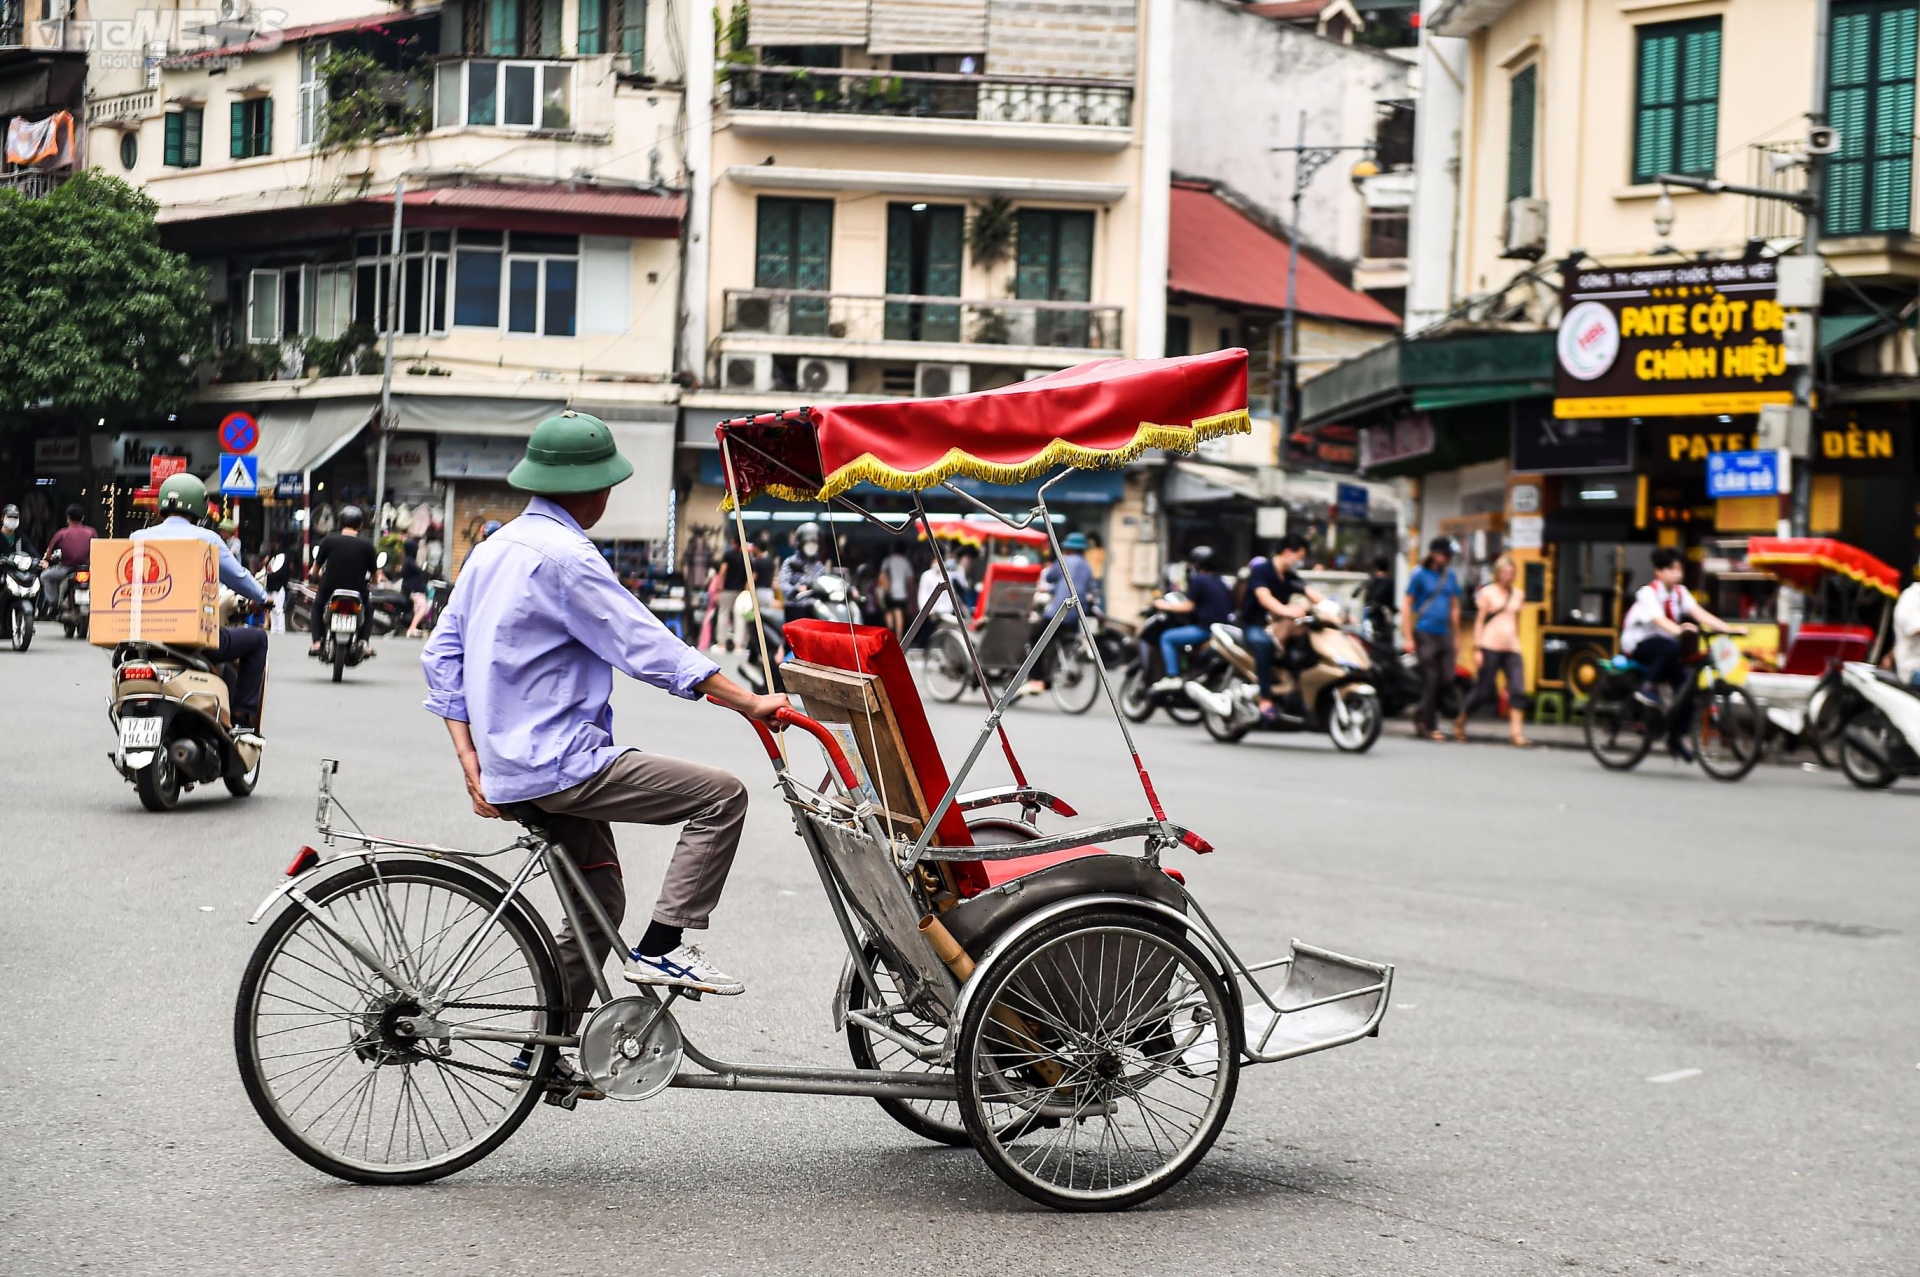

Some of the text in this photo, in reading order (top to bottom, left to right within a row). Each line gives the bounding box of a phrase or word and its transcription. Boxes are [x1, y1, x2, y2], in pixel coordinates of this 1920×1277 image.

[1620, 303, 1688, 337] PATE
[1690, 293, 1749, 340] CỘT
[1635, 336, 1788, 383] CHÍNH HIỆU
[1668, 433, 1745, 460] PATE
